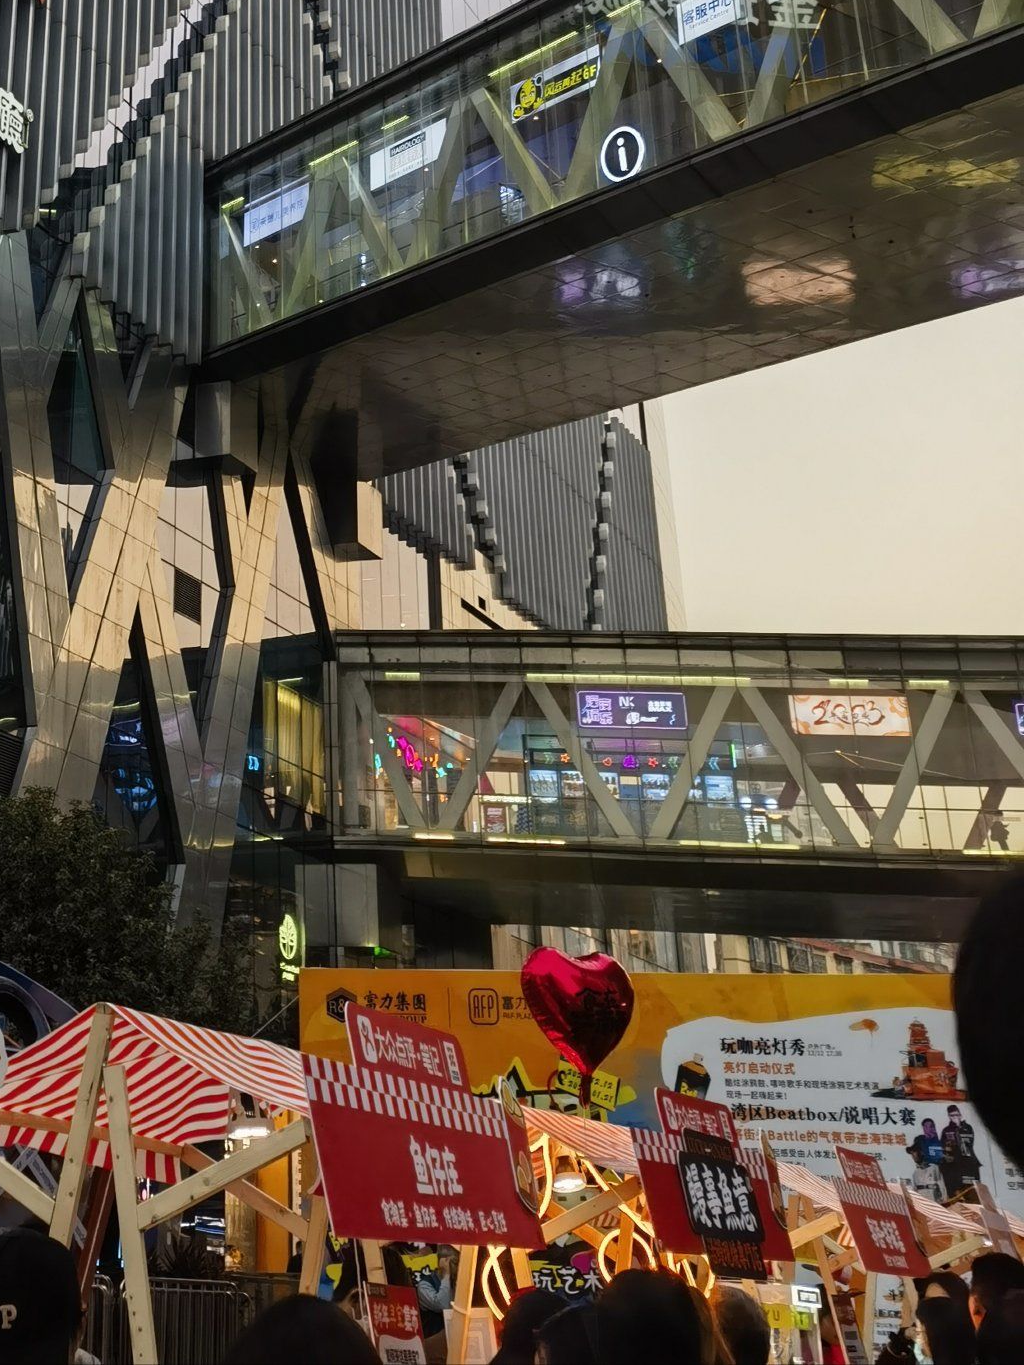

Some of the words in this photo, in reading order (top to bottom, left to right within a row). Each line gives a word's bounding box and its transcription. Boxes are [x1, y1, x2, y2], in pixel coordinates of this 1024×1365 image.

[363, 990, 427, 1013] 富力集團
[719, 1036, 805, 1058] 玩咖亮灯秀
[722, 1061, 797, 1076] 亮灯启动仪式
[0, 1303, 18, 1330] P
